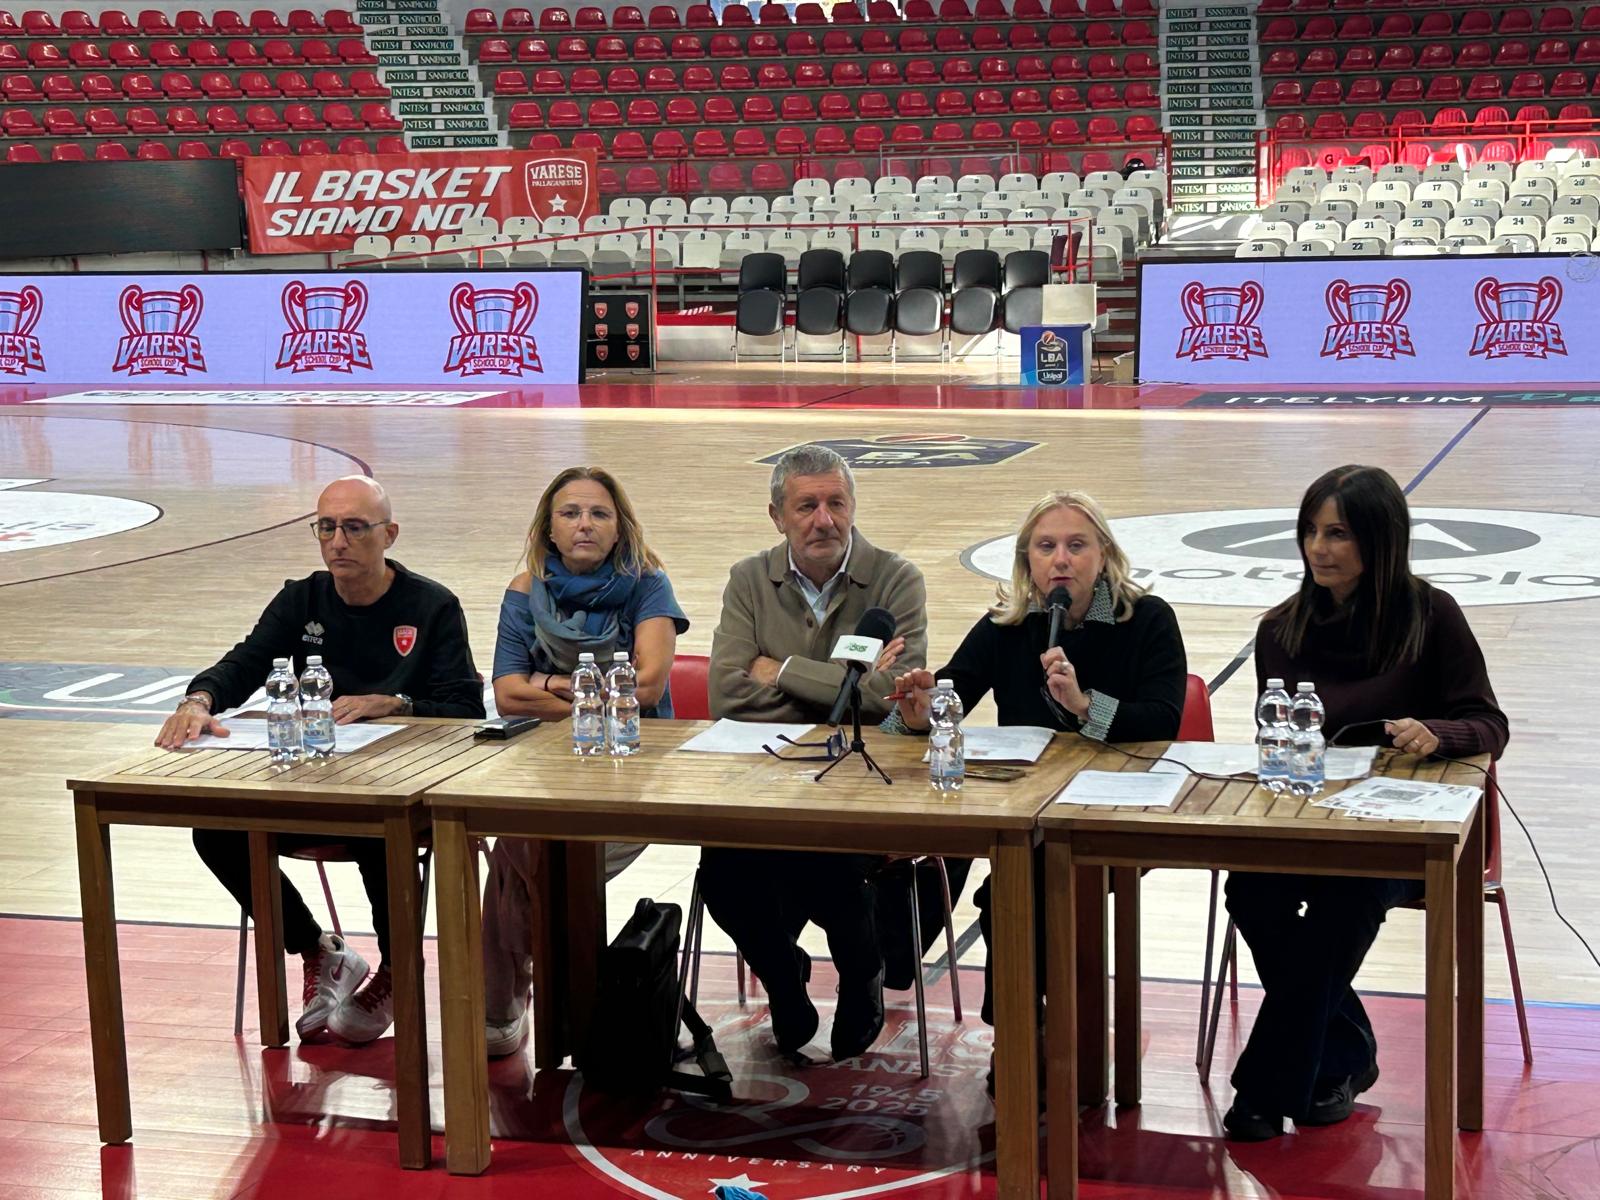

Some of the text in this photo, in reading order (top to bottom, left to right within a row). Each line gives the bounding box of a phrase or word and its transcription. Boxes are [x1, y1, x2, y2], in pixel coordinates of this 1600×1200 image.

[264, 166, 512, 203] IL BASKET
[530, 165, 582, 179] VARESE
[266, 206, 402, 237] SIAMO
[116, 335, 204, 370] VARESE
[277, 331, 370, 367] VARESE
[446, 334, 541, 371] VARESE
[1178, 325, 1266, 356] VARESE
[1322, 323, 1414, 356] VARESE
[1473, 322, 1565, 354] VARESE
[473, 358, 510, 368] SCHOOL CUP
[1040, 353, 1064, 362] LBA
[818, 1097, 932, 1116] 2025
[851, 1084, 943, 1102] 1945
[631, 1149, 886, 1174] ANNIVERSARY
